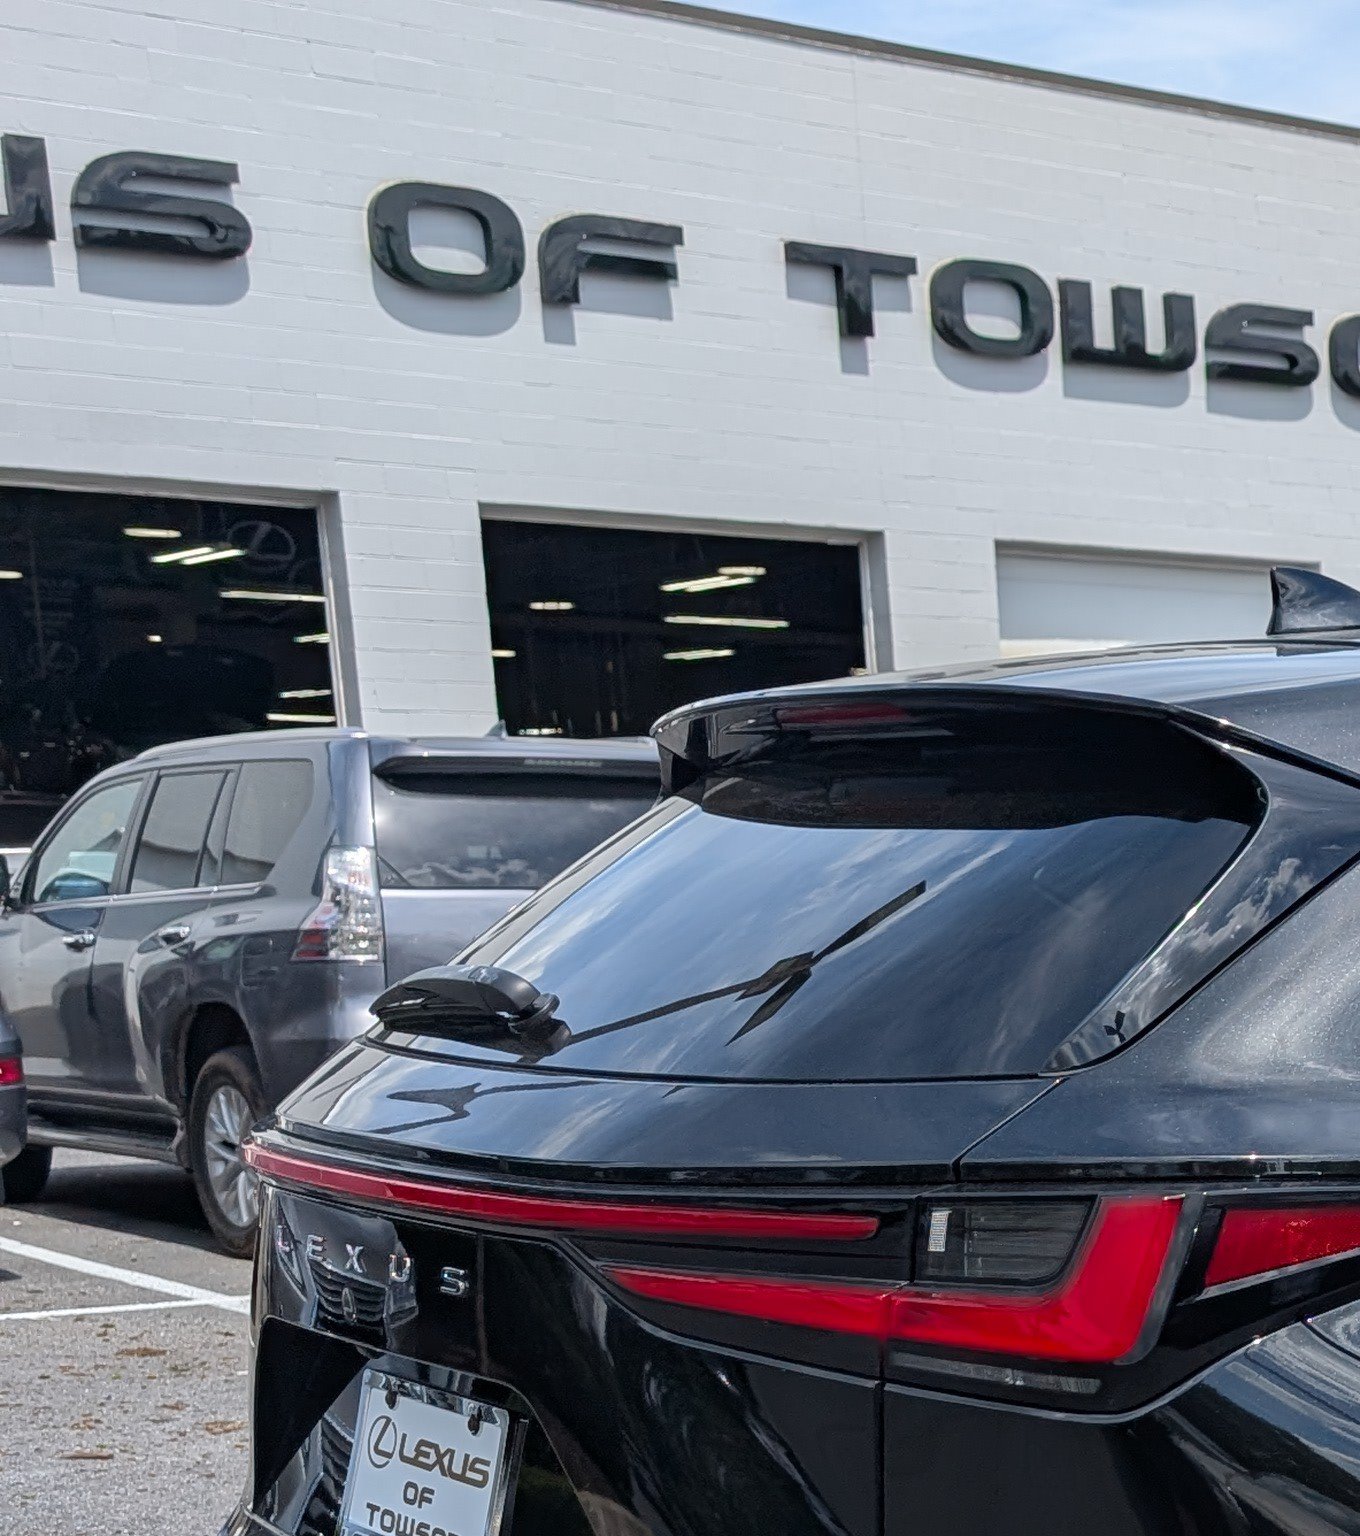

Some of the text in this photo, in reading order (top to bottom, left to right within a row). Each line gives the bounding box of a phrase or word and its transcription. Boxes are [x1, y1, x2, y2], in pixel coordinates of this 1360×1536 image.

[367, 182, 685, 305] OF
[276, 1225, 470, 1297] LEXUS
[399, 1432, 492, 1490] LEXUS
[403, 1480, 435, 1509] OF
